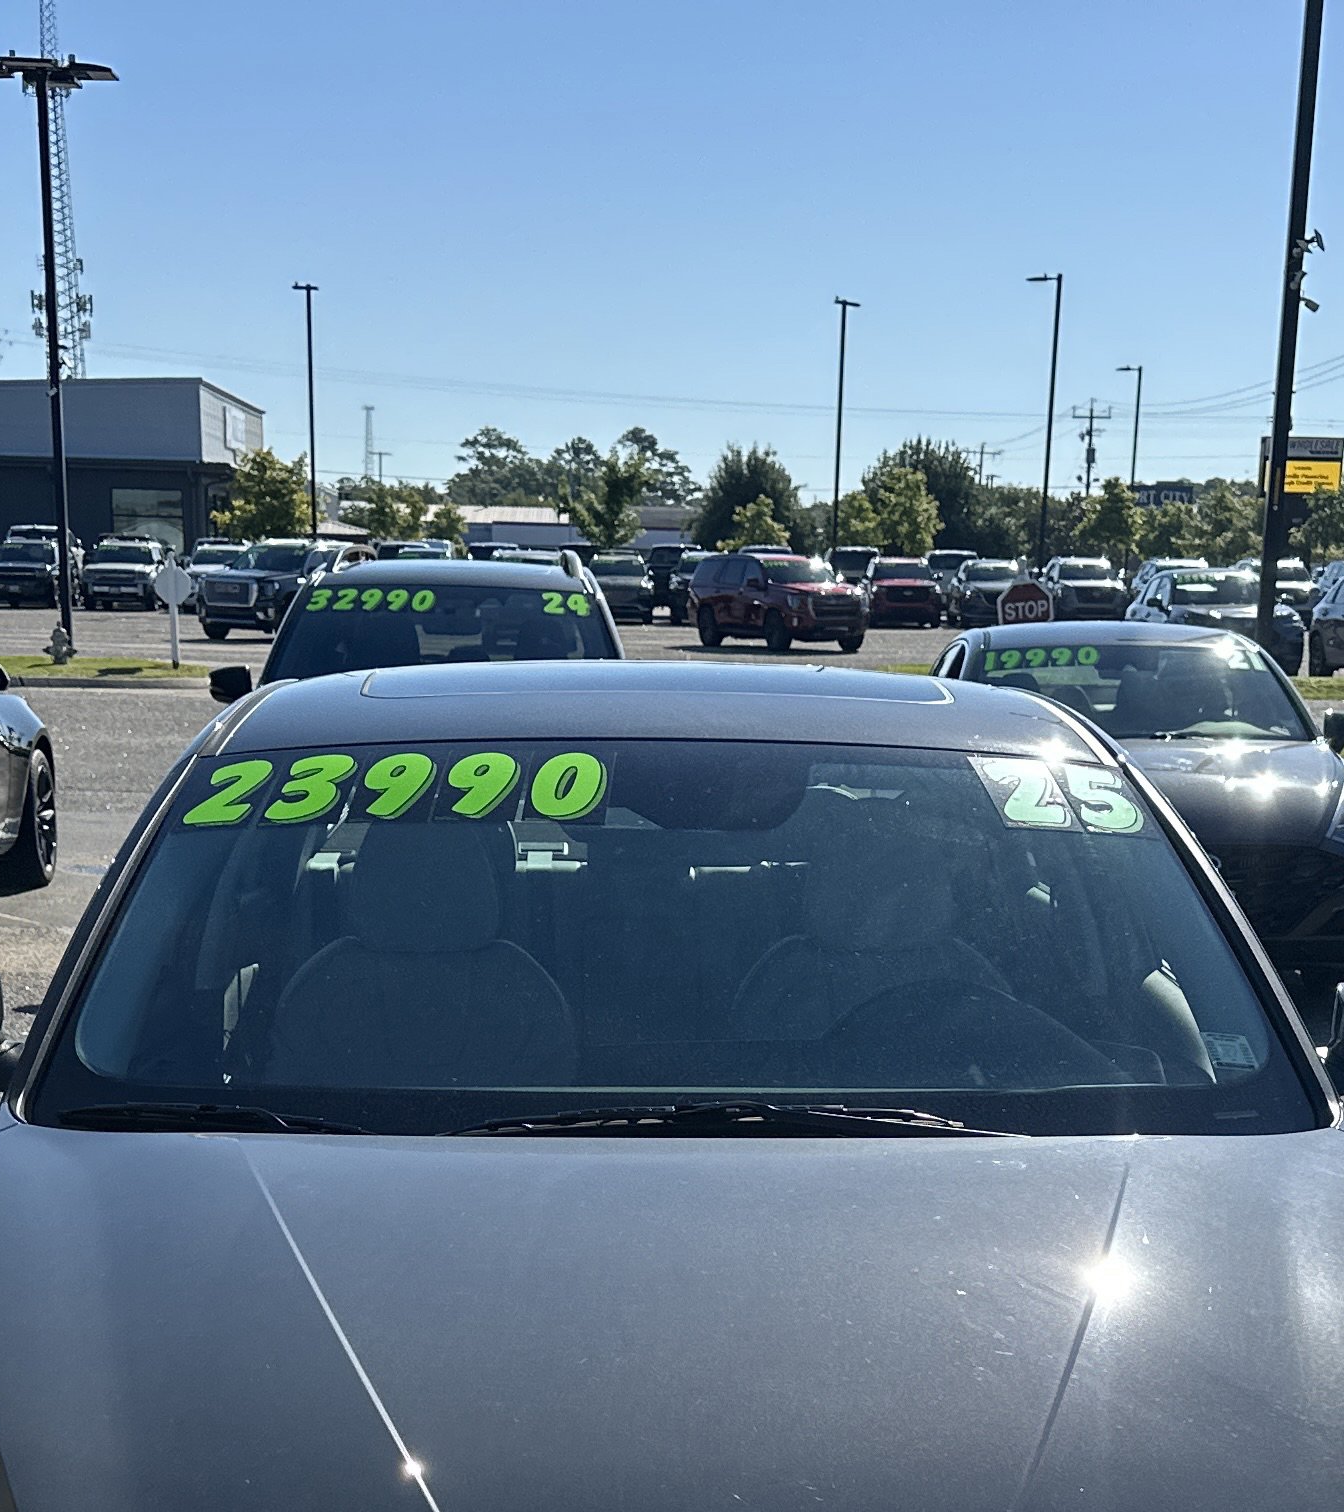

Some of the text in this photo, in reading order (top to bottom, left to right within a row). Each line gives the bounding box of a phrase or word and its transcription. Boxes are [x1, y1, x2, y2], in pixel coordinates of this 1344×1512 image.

[306, 588, 591, 617] 32990 24
[1004, 600, 1049, 620] STOP
[984, 646, 1100, 672] 19990
[182, 752, 1145, 834] 23990 25
